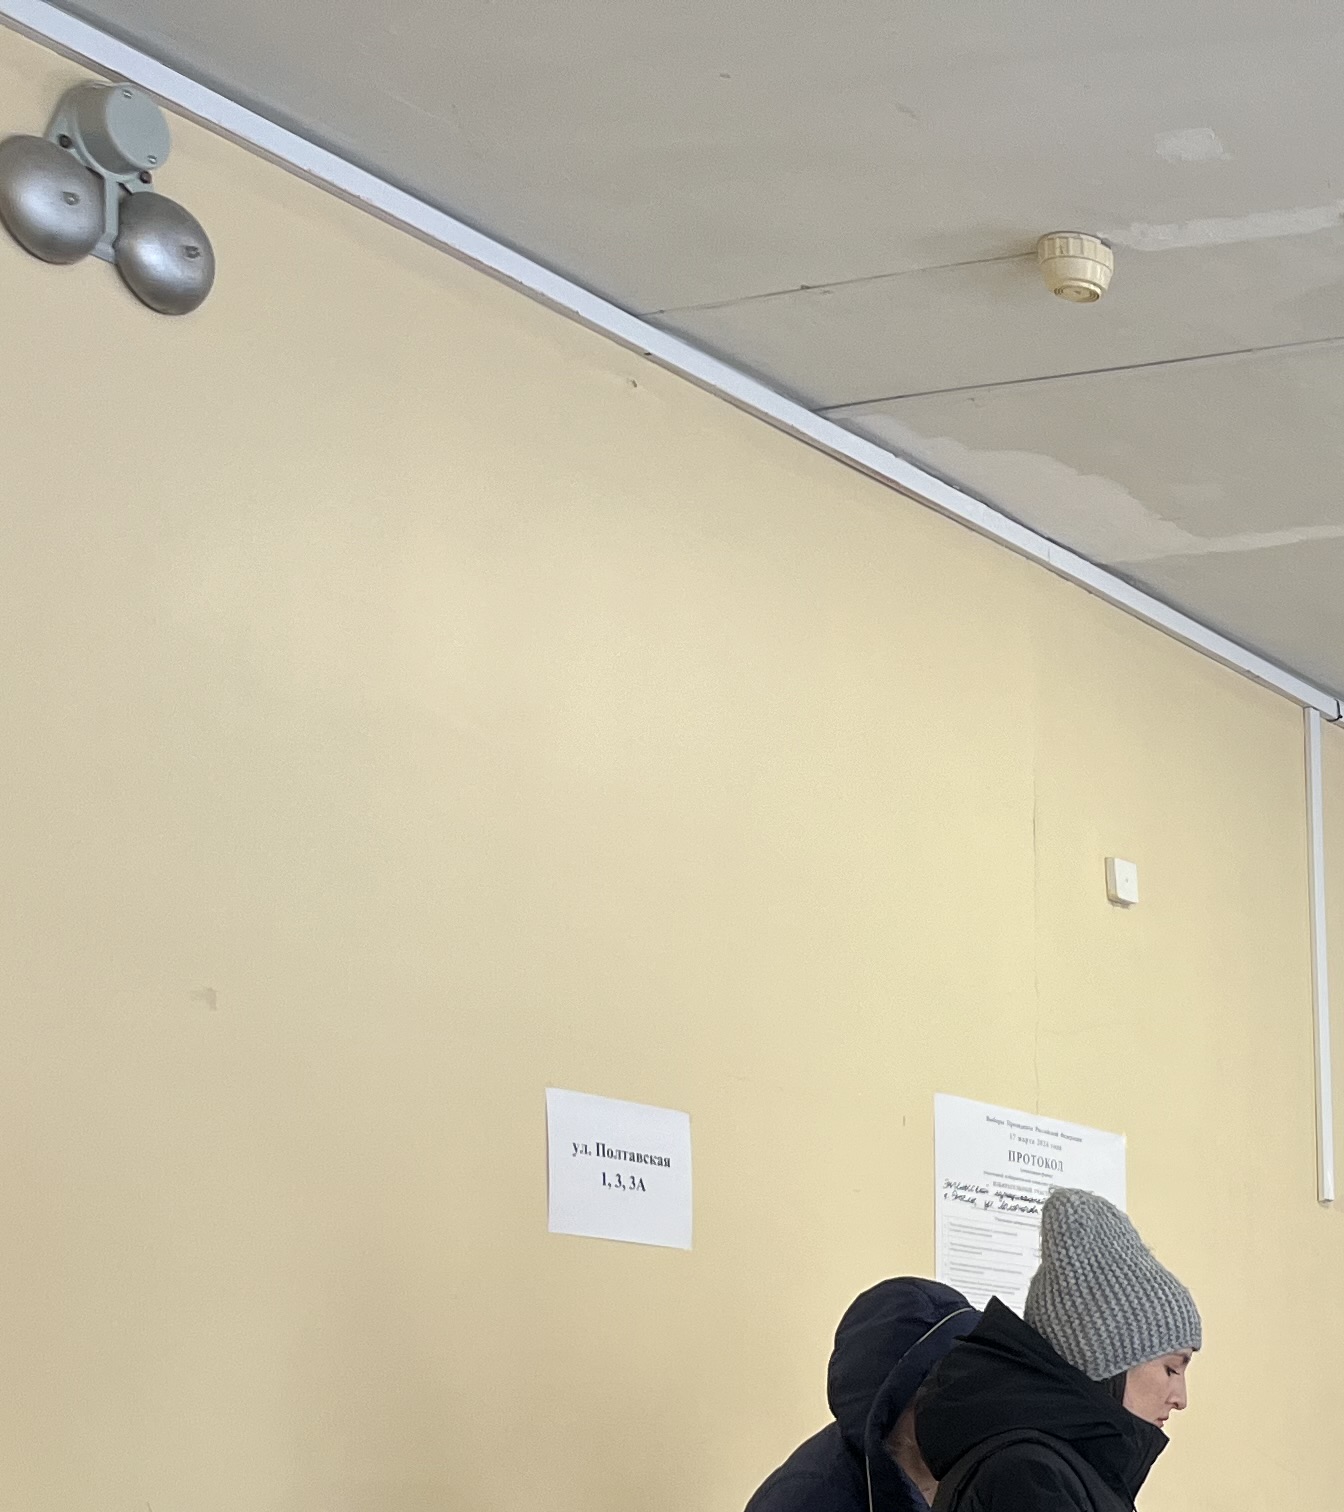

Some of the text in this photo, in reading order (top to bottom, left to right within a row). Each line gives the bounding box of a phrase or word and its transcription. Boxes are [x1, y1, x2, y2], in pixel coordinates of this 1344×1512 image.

[572, 1142, 671, 1168] ул. Полтавская
[1008, 1150, 1064, 1172] ПРОТОКОЛ
[602, 1171, 646, 1193] 1, 3, 3А
